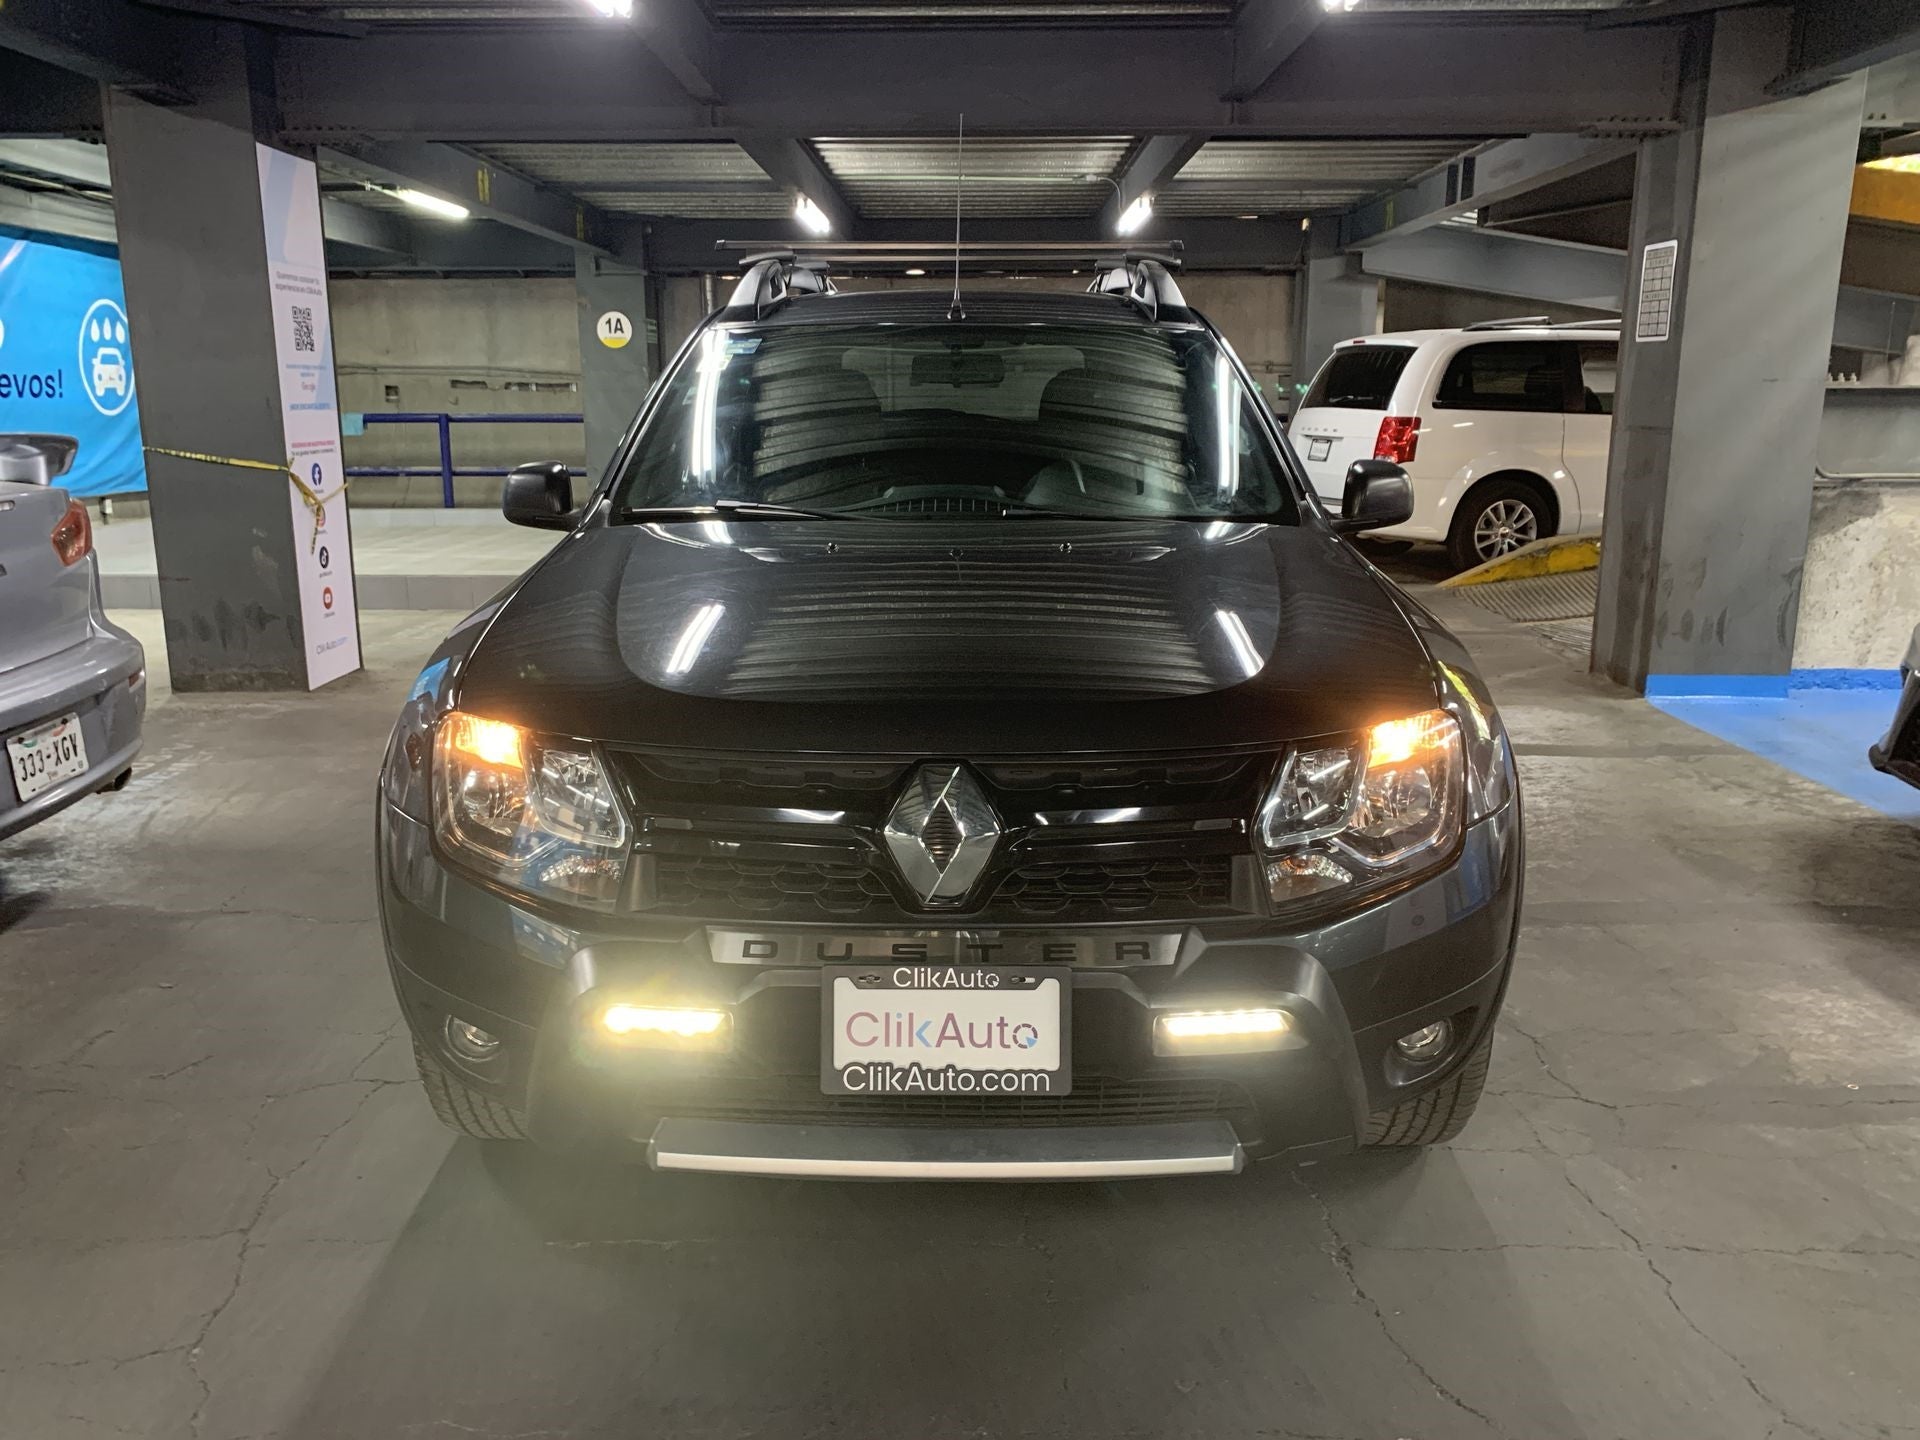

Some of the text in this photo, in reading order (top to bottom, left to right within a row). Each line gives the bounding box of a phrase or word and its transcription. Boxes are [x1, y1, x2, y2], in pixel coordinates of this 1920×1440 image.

[605, 317, 625, 335] 1A
[18, 732, 78, 782] 333-XGV
[742, 939, 1151, 963] DUSTER
[893, 967, 1000, 988] ClikAuto
[846, 1011, 1039, 1050] ClikAuto
[843, 1065, 1050, 1092] ClikAuto.com
